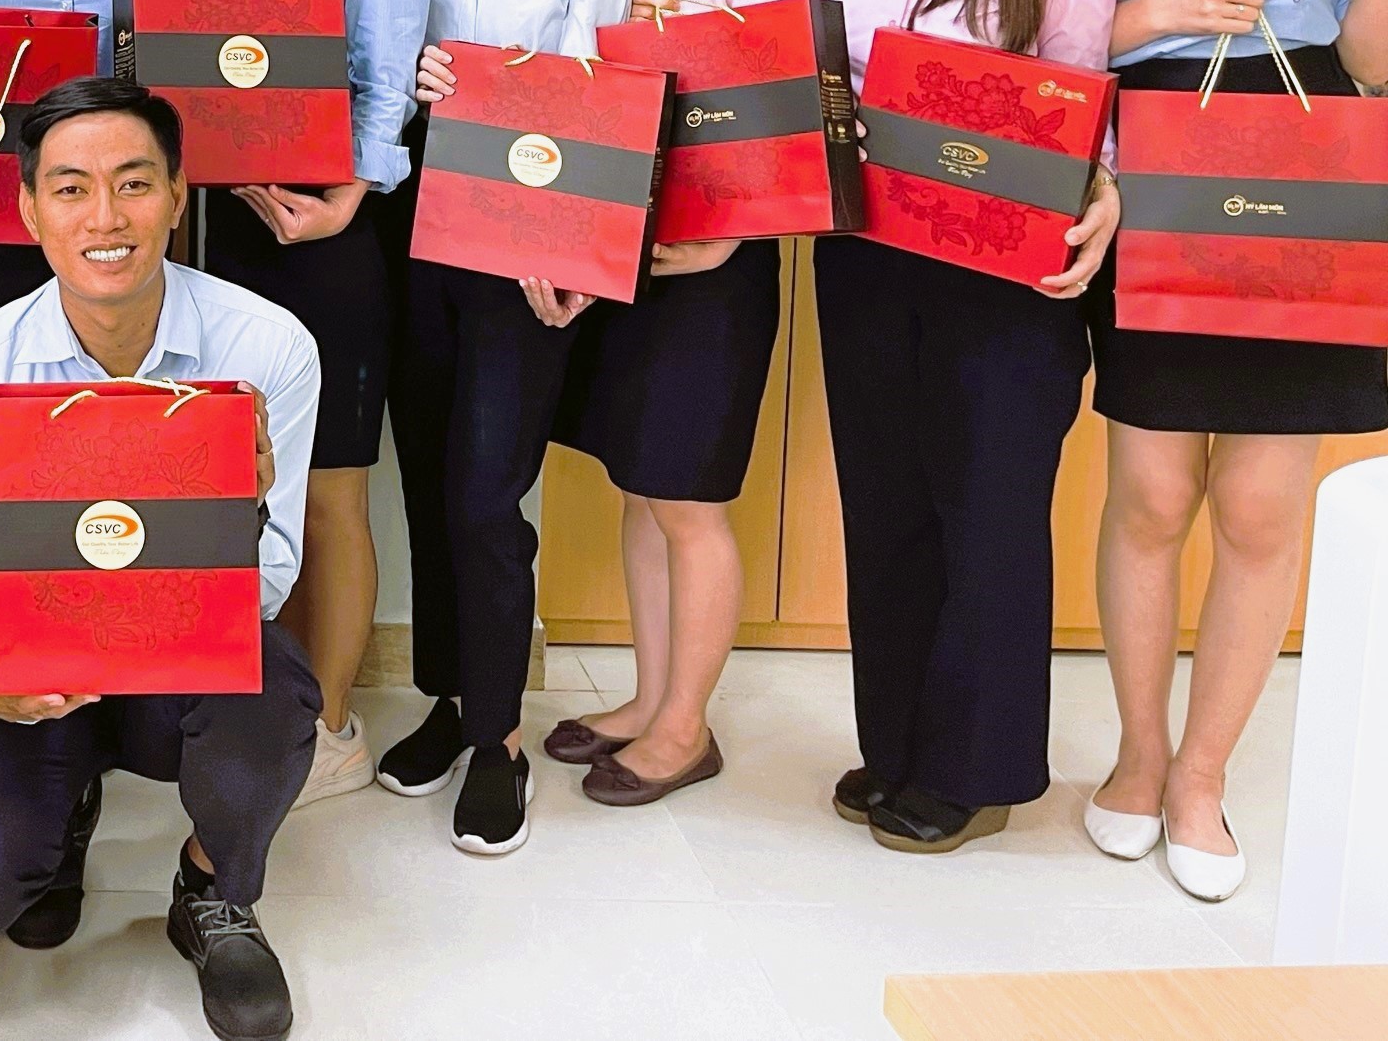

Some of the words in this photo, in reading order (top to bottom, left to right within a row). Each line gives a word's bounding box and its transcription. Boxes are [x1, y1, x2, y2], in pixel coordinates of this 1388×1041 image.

[225, 52, 252, 61] CSVC
[516, 148, 545, 161] CSVC
[942, 146, 975, 161] CSVC
[85, 523, 122, 535] CSVC
